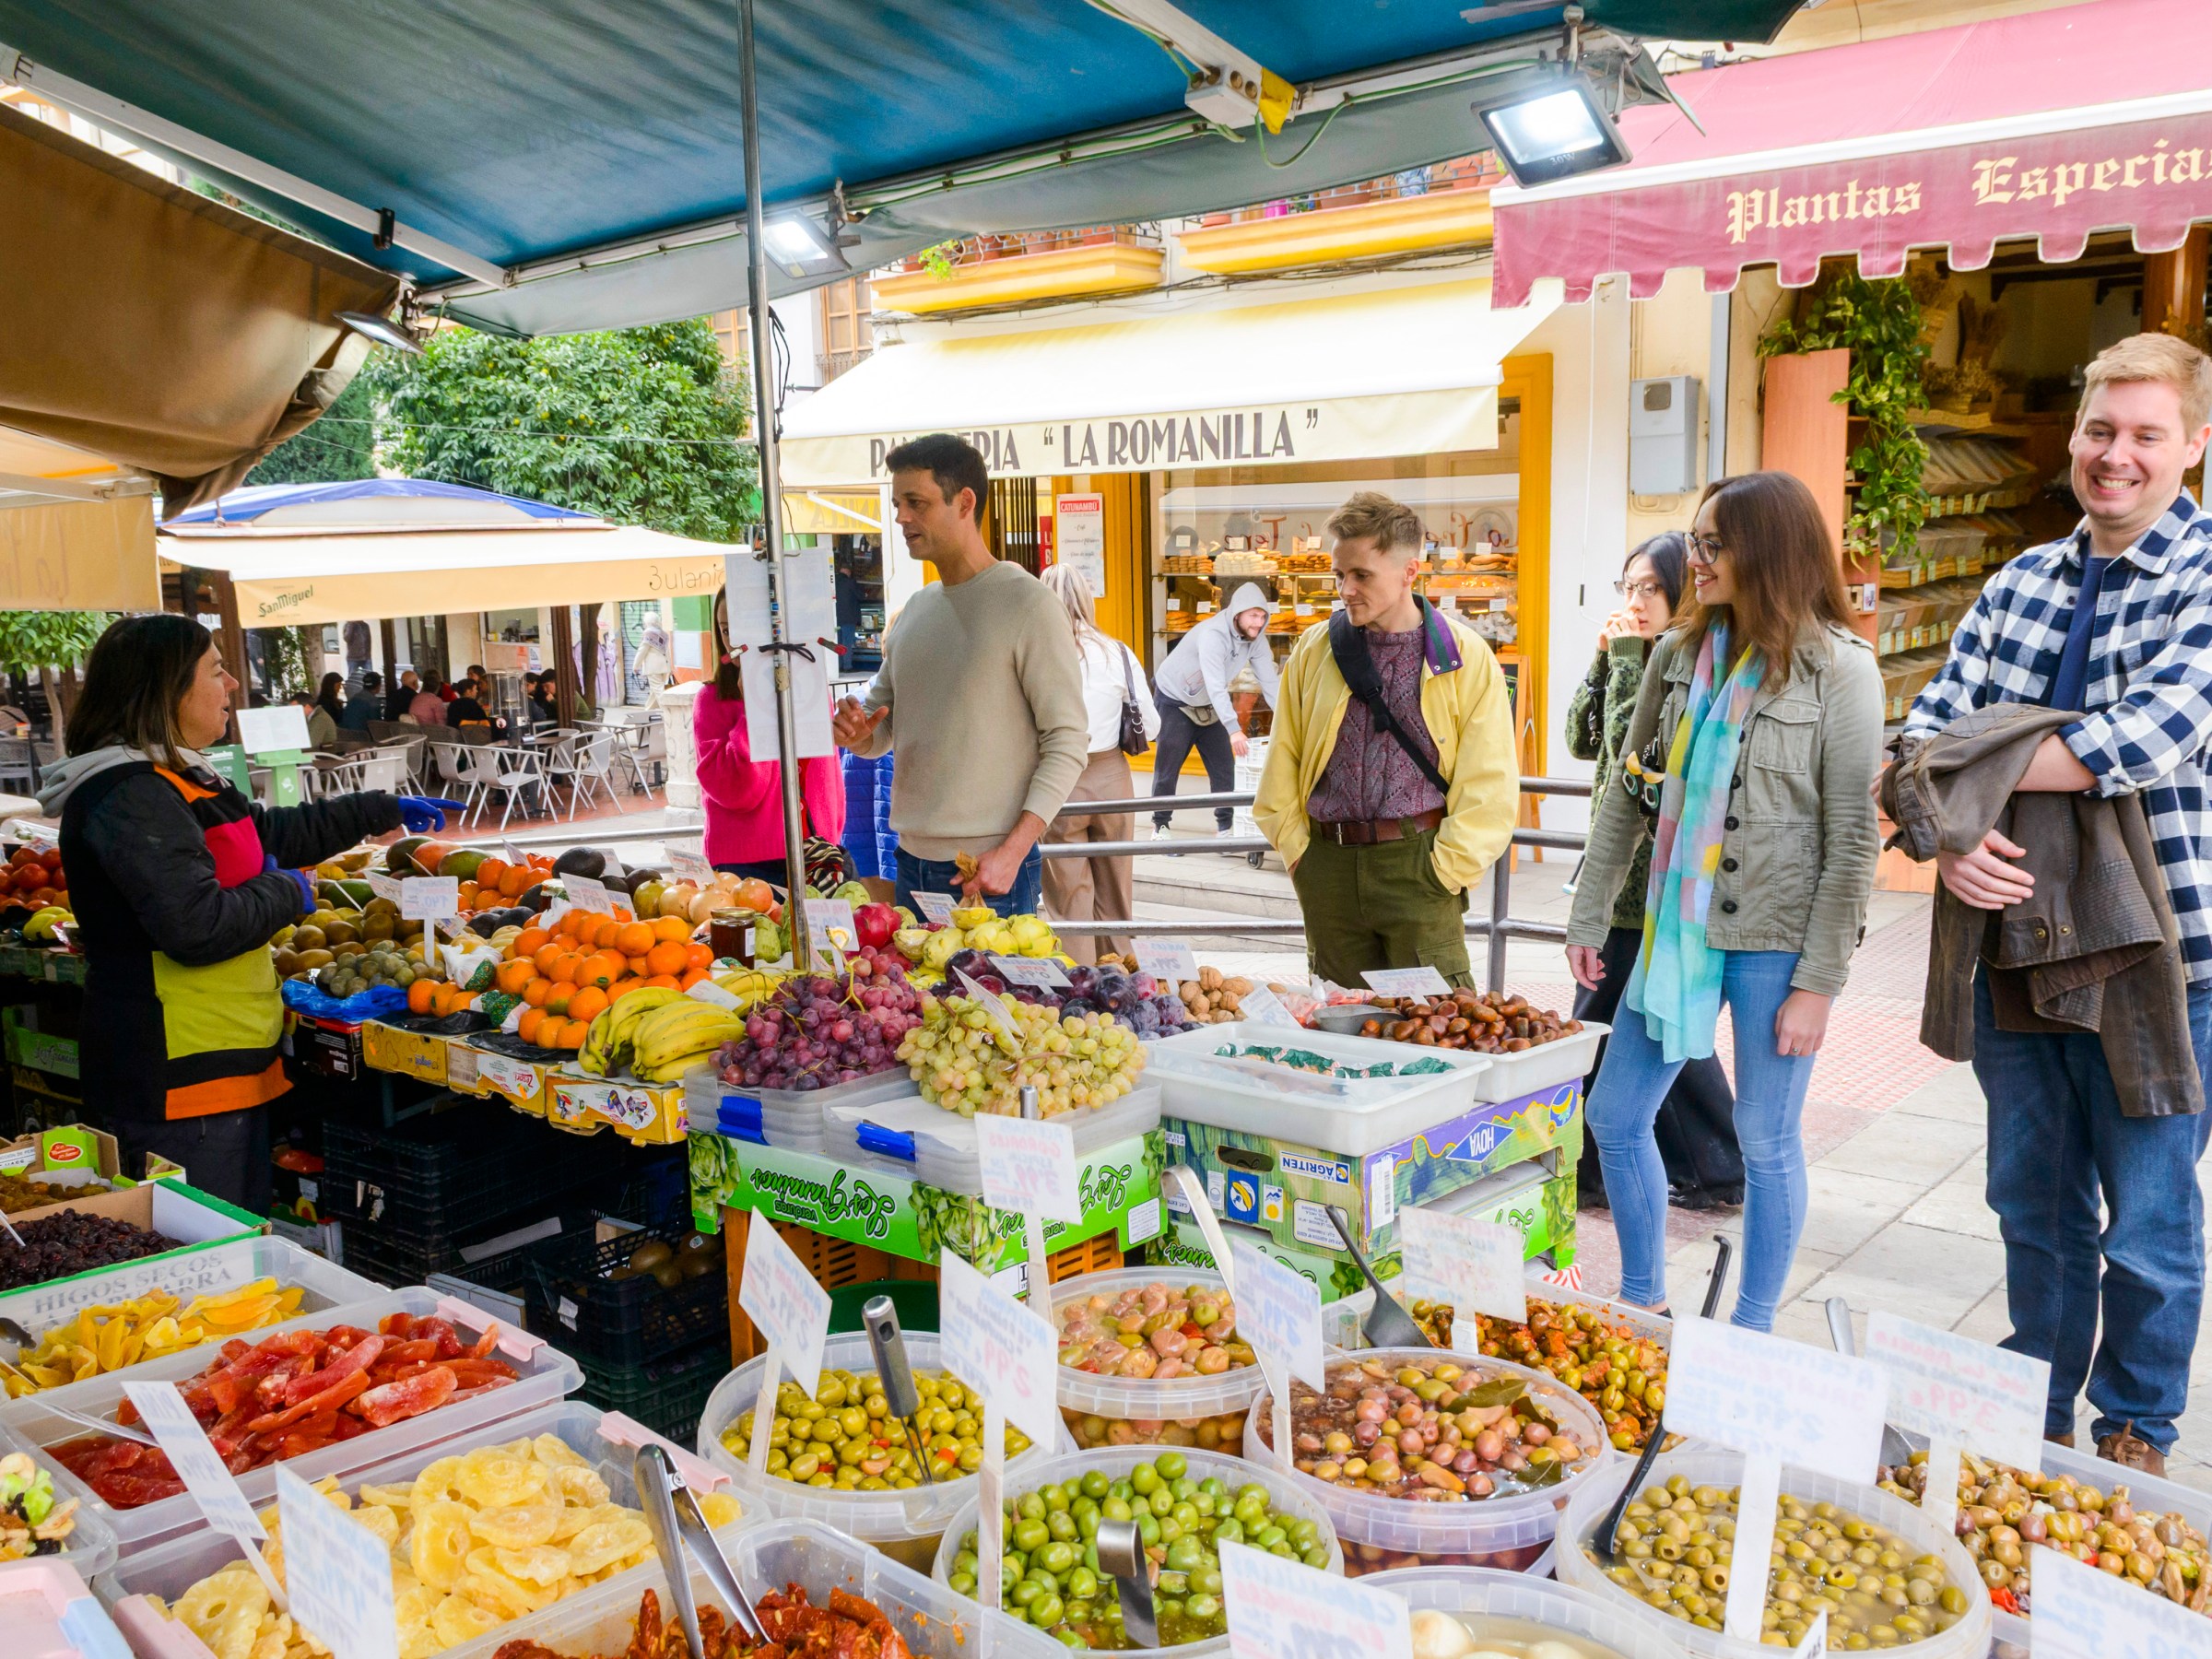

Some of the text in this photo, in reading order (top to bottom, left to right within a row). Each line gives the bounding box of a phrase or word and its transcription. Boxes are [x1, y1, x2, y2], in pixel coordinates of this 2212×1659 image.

[1725, 179, 1922, 244] Plantas
[1469, 1126, 1494, 1157] HOYA
[1092, 1164, 1133, 1212] Los
[1282, 1158, 1335, 1177] AGRITEN
[773, 1200, 818, 1224] verduras
[851, 1180, 896, 1238] Los
[35, 1252, 223, 1314] HIGOS SECOS
